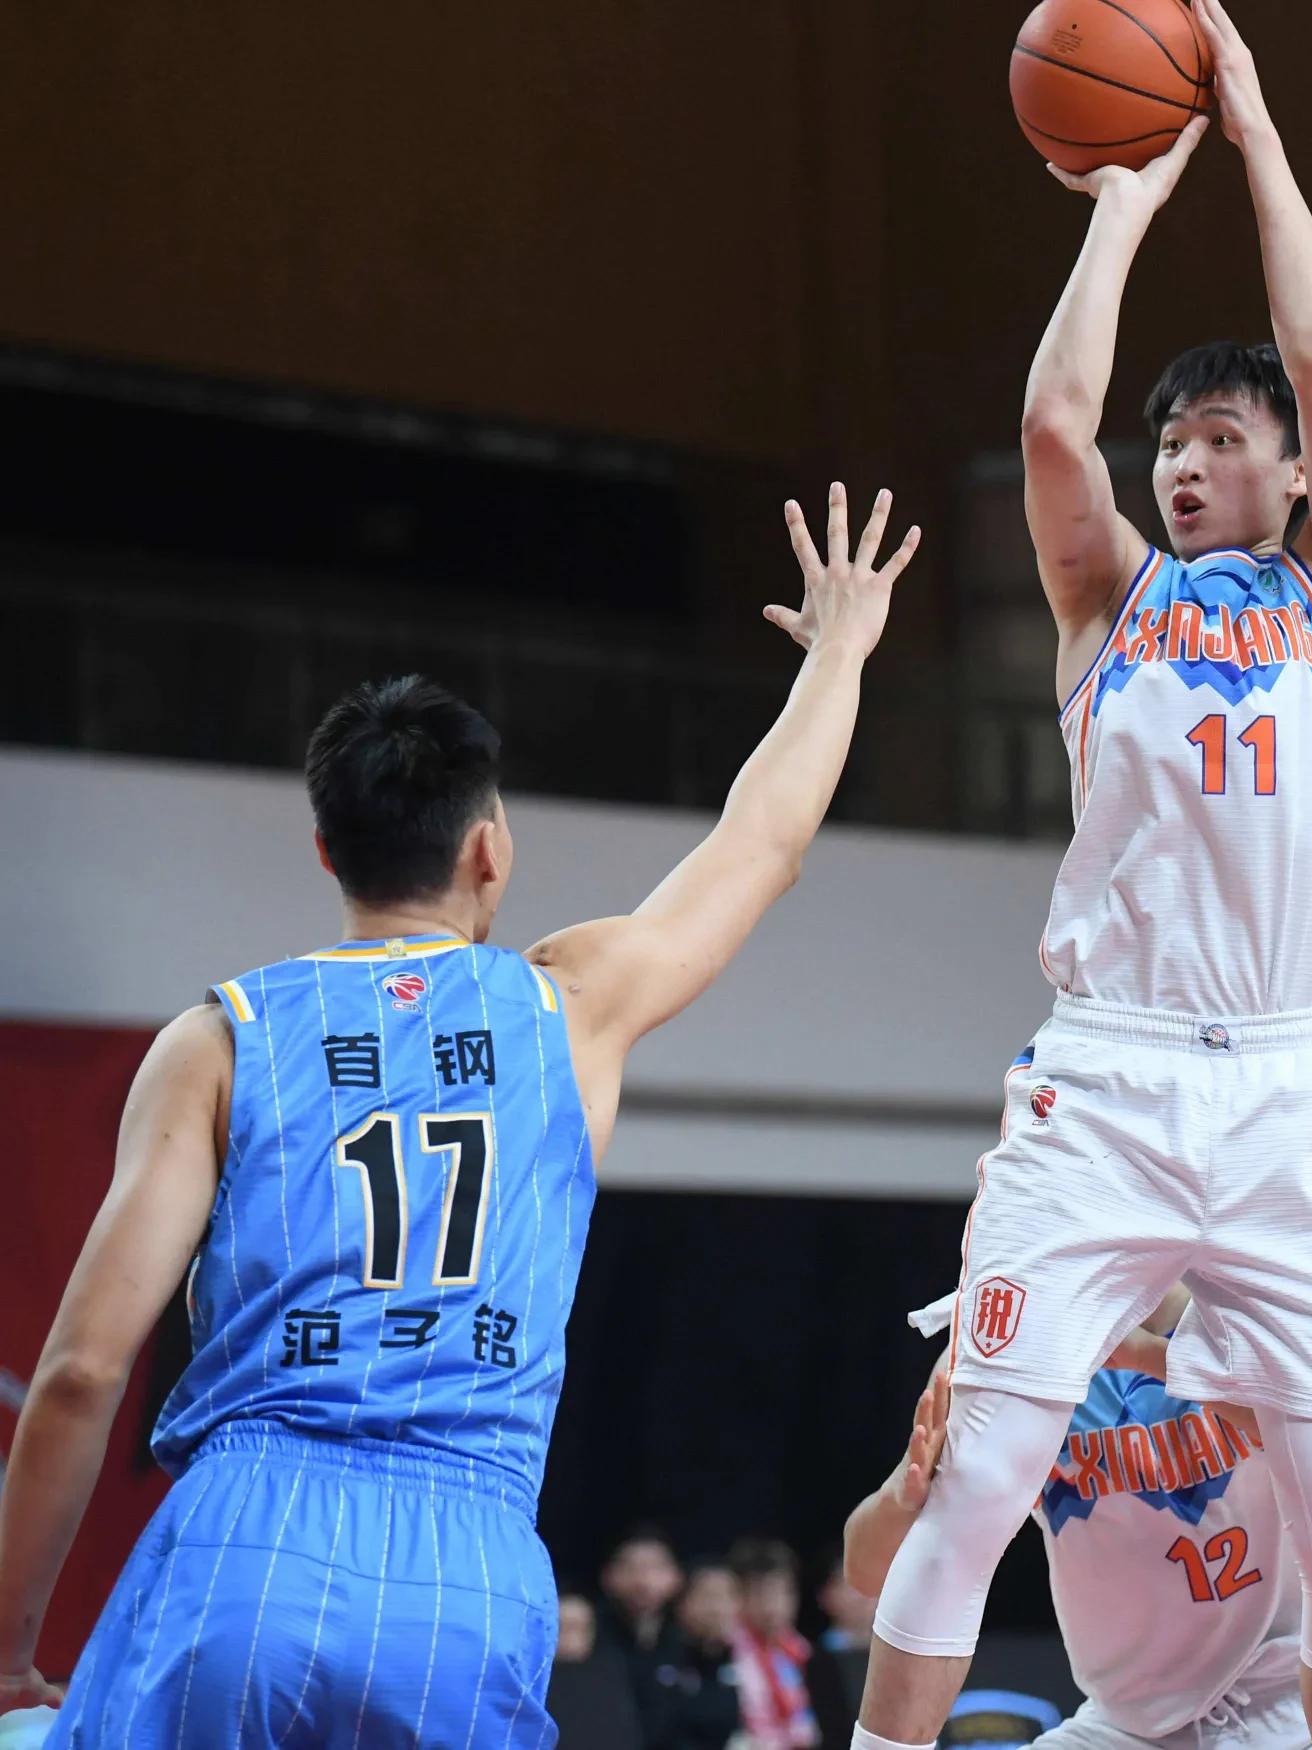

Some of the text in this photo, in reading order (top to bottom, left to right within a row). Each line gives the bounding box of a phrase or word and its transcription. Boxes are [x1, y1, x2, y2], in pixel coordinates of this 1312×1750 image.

[1184, 713, 1277, 796] 11
[320, 1029, 496, 1089] 首钢
[336, 1111, 495, 1290] 17
[279, 1303, 518, 1369] 范子铭
[1068, 1404, 1264, 1500] XINJIAN
[1165, 1526, 1263, 1602] 12
